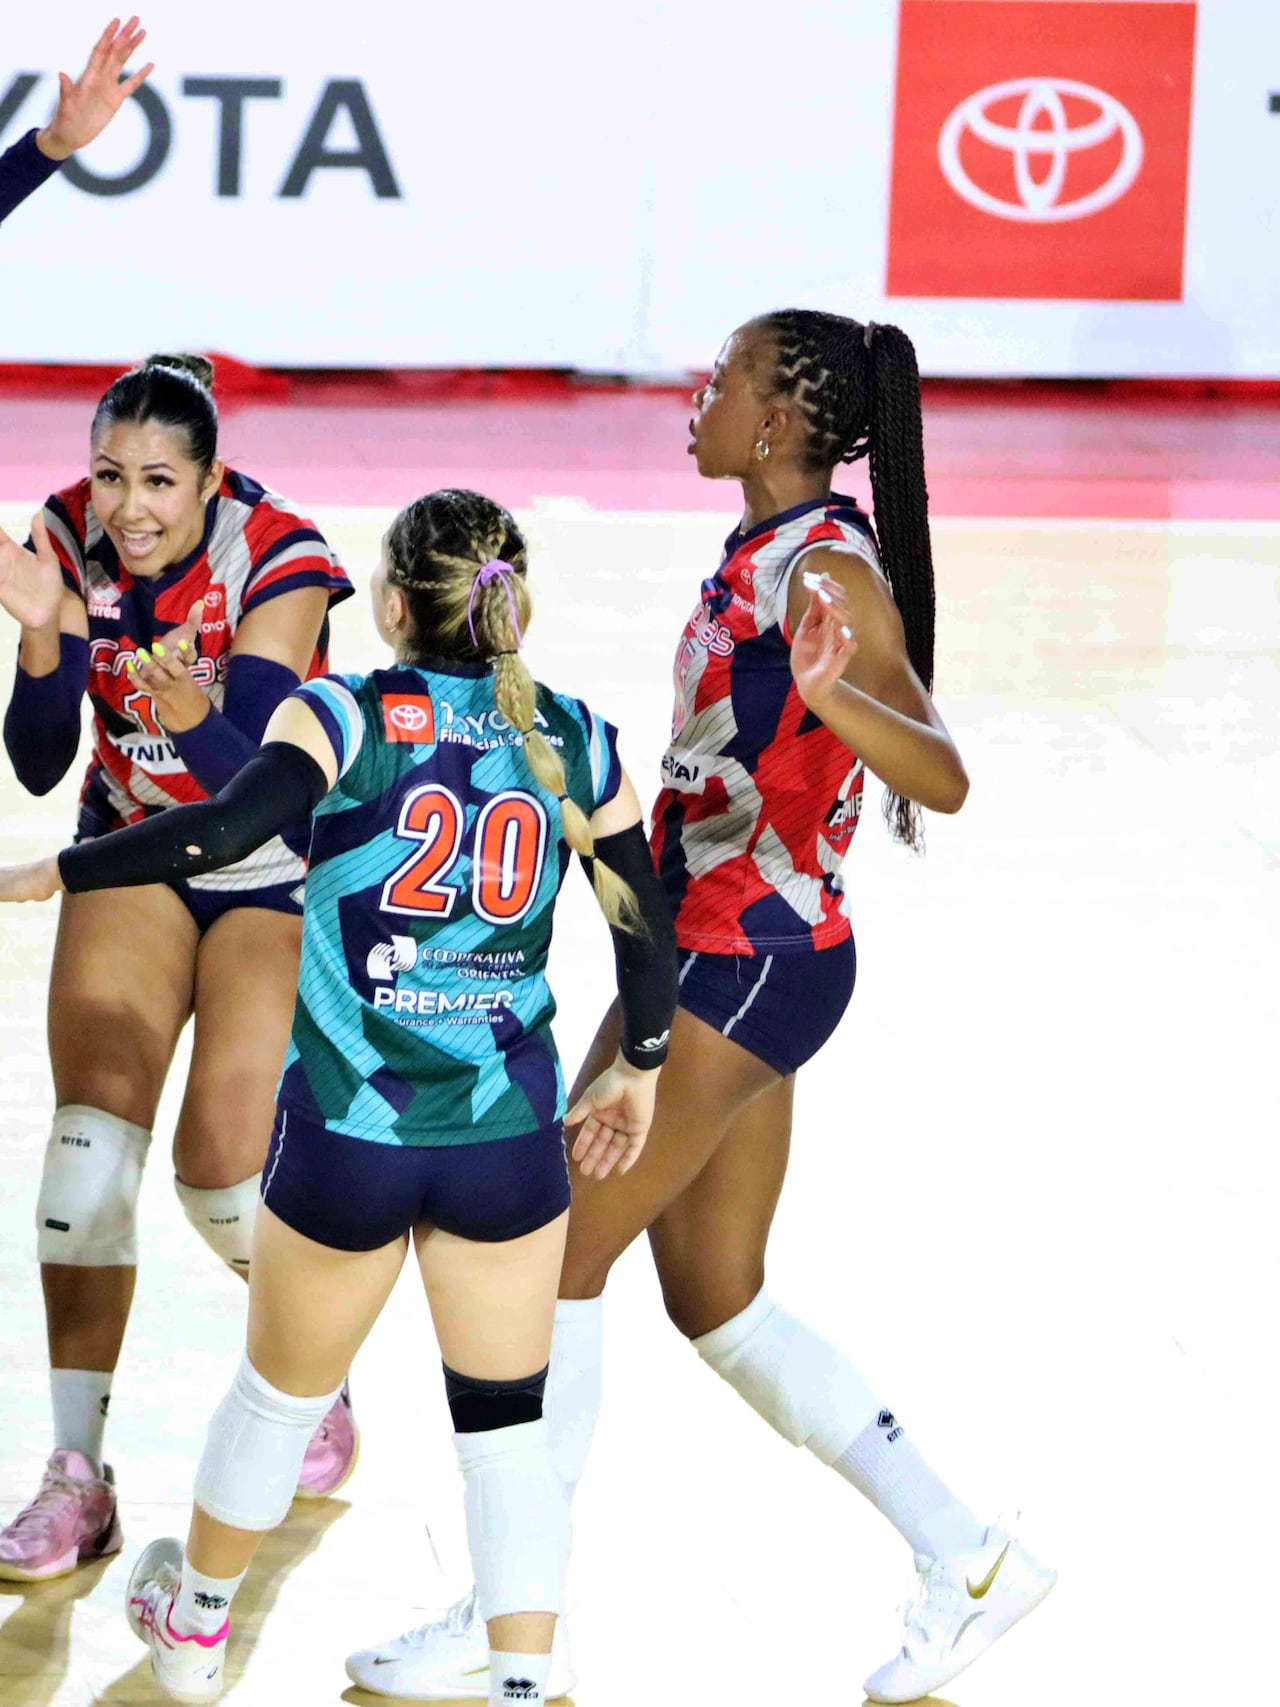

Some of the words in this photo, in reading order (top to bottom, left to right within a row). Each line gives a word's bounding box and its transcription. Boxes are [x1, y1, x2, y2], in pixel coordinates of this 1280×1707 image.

[379, 783, 547, 926] 20
[373, 986, 514, 1015] PREMIER
[447, 1013, 504, 1026] Warranties
